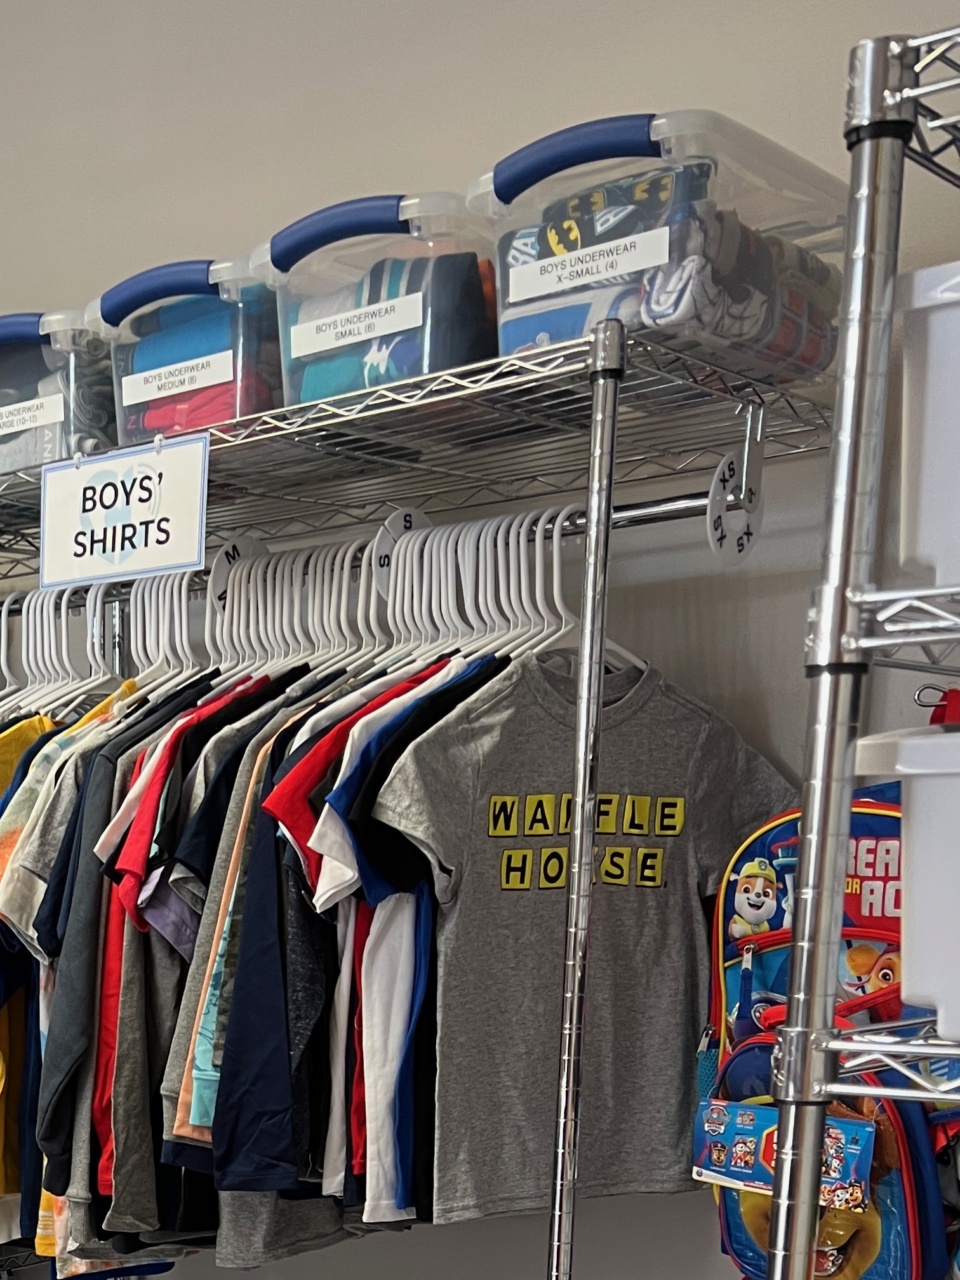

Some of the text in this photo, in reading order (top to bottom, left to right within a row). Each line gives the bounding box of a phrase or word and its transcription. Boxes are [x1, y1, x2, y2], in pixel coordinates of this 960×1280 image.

[540, 241, 638, 276] BOYS UNDERWEAR
[555, 260, 618, 285] X-SMALL (4)
[315, 304, 396, 335] BOYS UNDERWEAR
[335, 321, 376, 341] SMALL (6)
[143, 360, 211, 385] BOYS UNDERWEAR
[157, 375, 197, 392] MEDIUM (8)
[5, 402, 44, 420] UNDERWEAR
[81, 472, 164, 514] BOYS'
[403, 513, 413, 530] S
[72, 516, 172, 559] SHIRTS
[224, 543, 241, 566] M
[378, 553, 391, 569] S
[505, 851, 659, 885] HOSE
